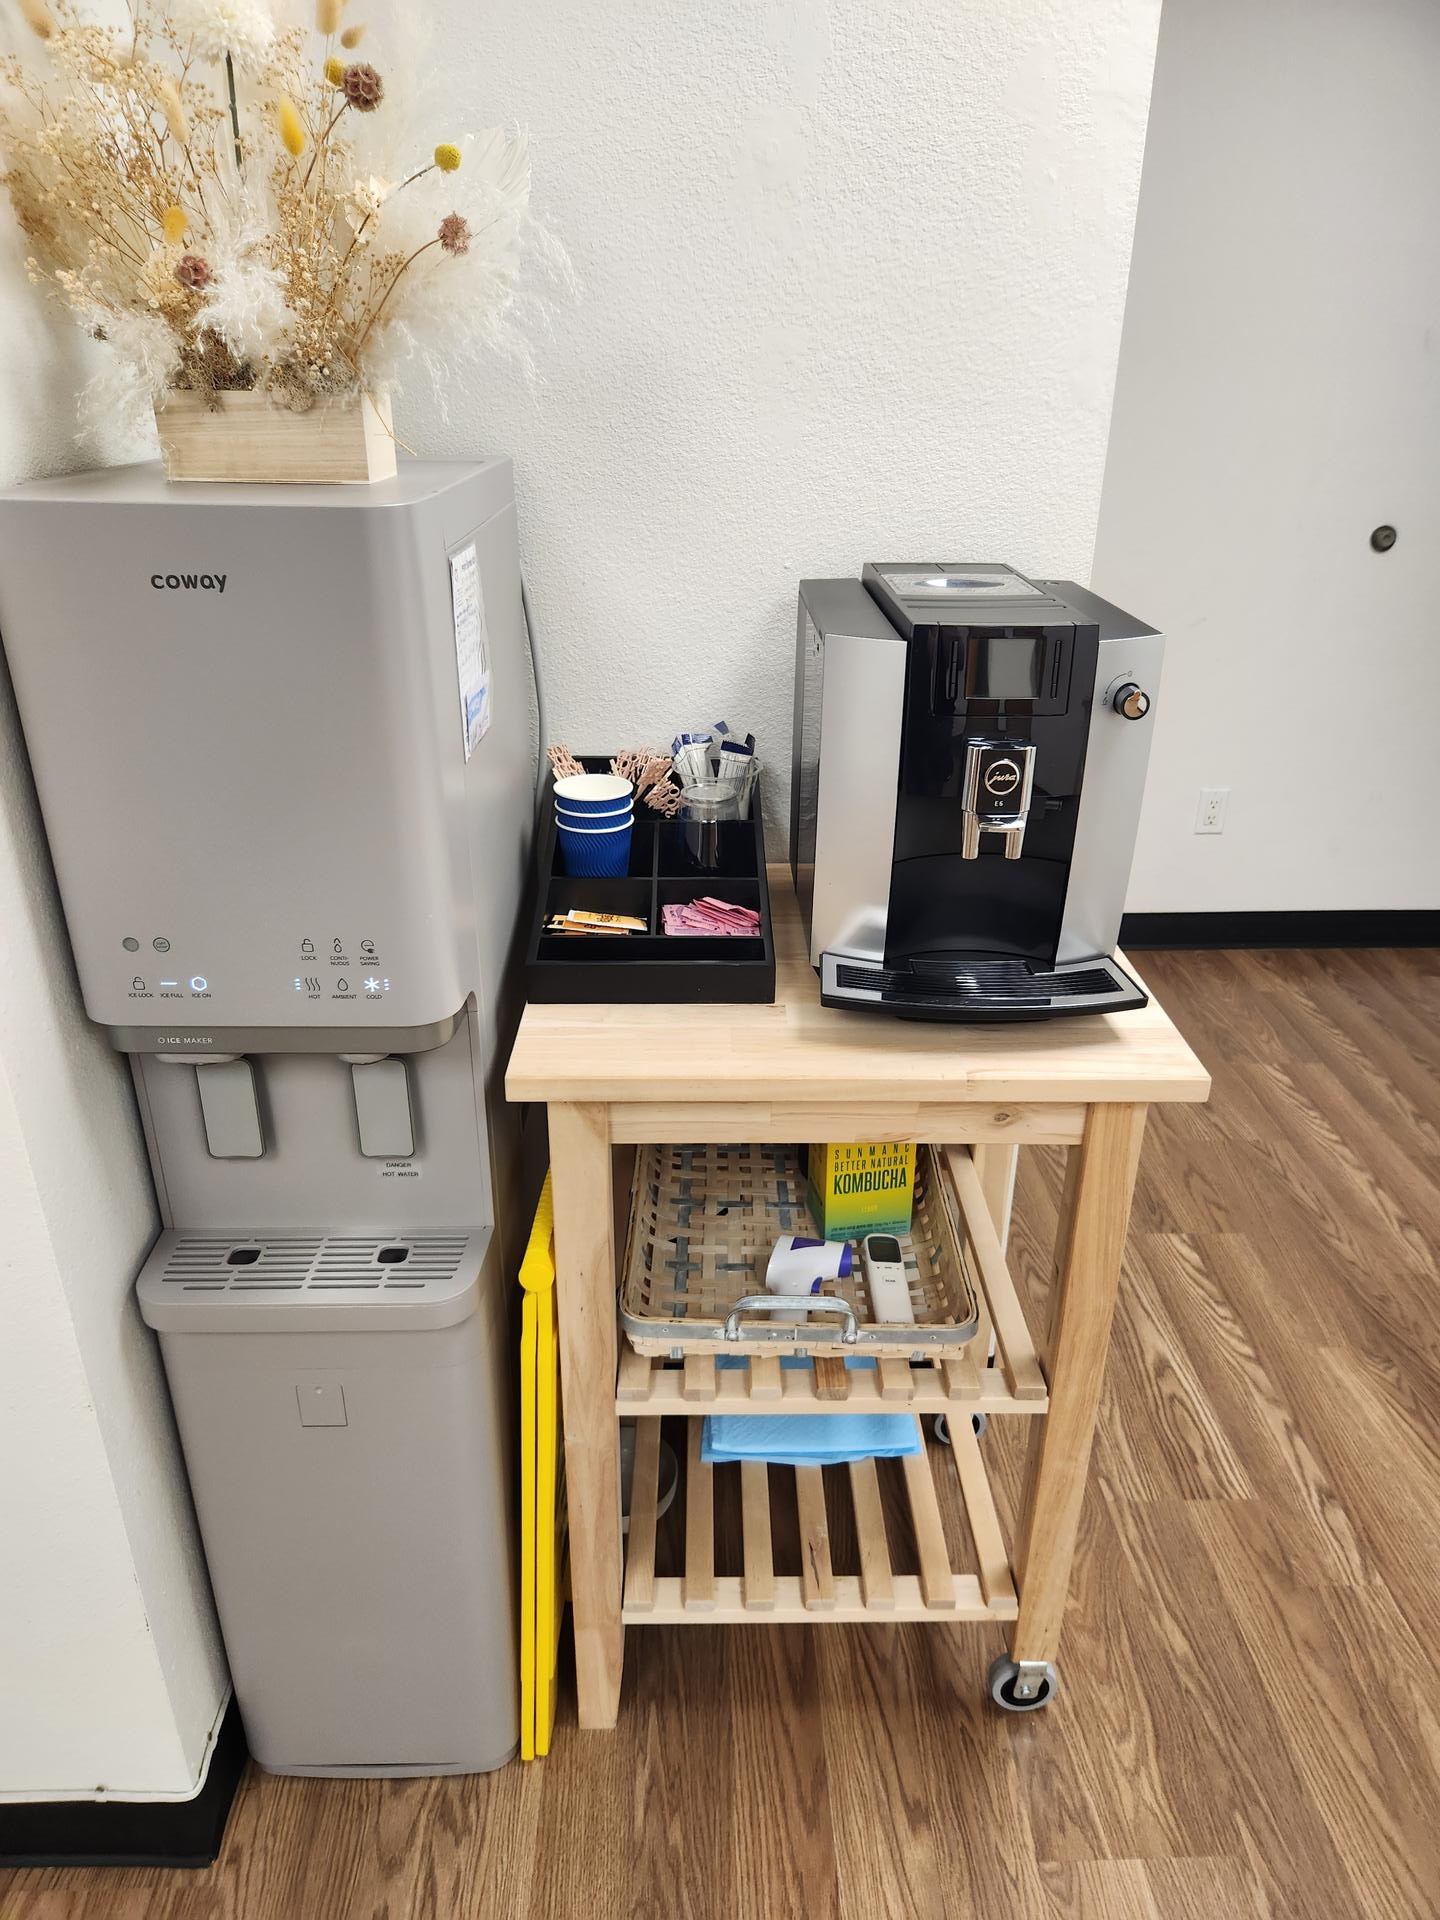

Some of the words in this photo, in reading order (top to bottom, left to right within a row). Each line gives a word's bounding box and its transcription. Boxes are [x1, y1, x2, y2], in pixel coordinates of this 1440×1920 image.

[150, 574, 227, 593] coway
[987, 771, 1017, 785] jura
[834, 1159, 867, 1172] BETTER
[870, 1155, 909, 1169] NATURAL
[833, 1167, 907, 1195] KOMBUCHA
